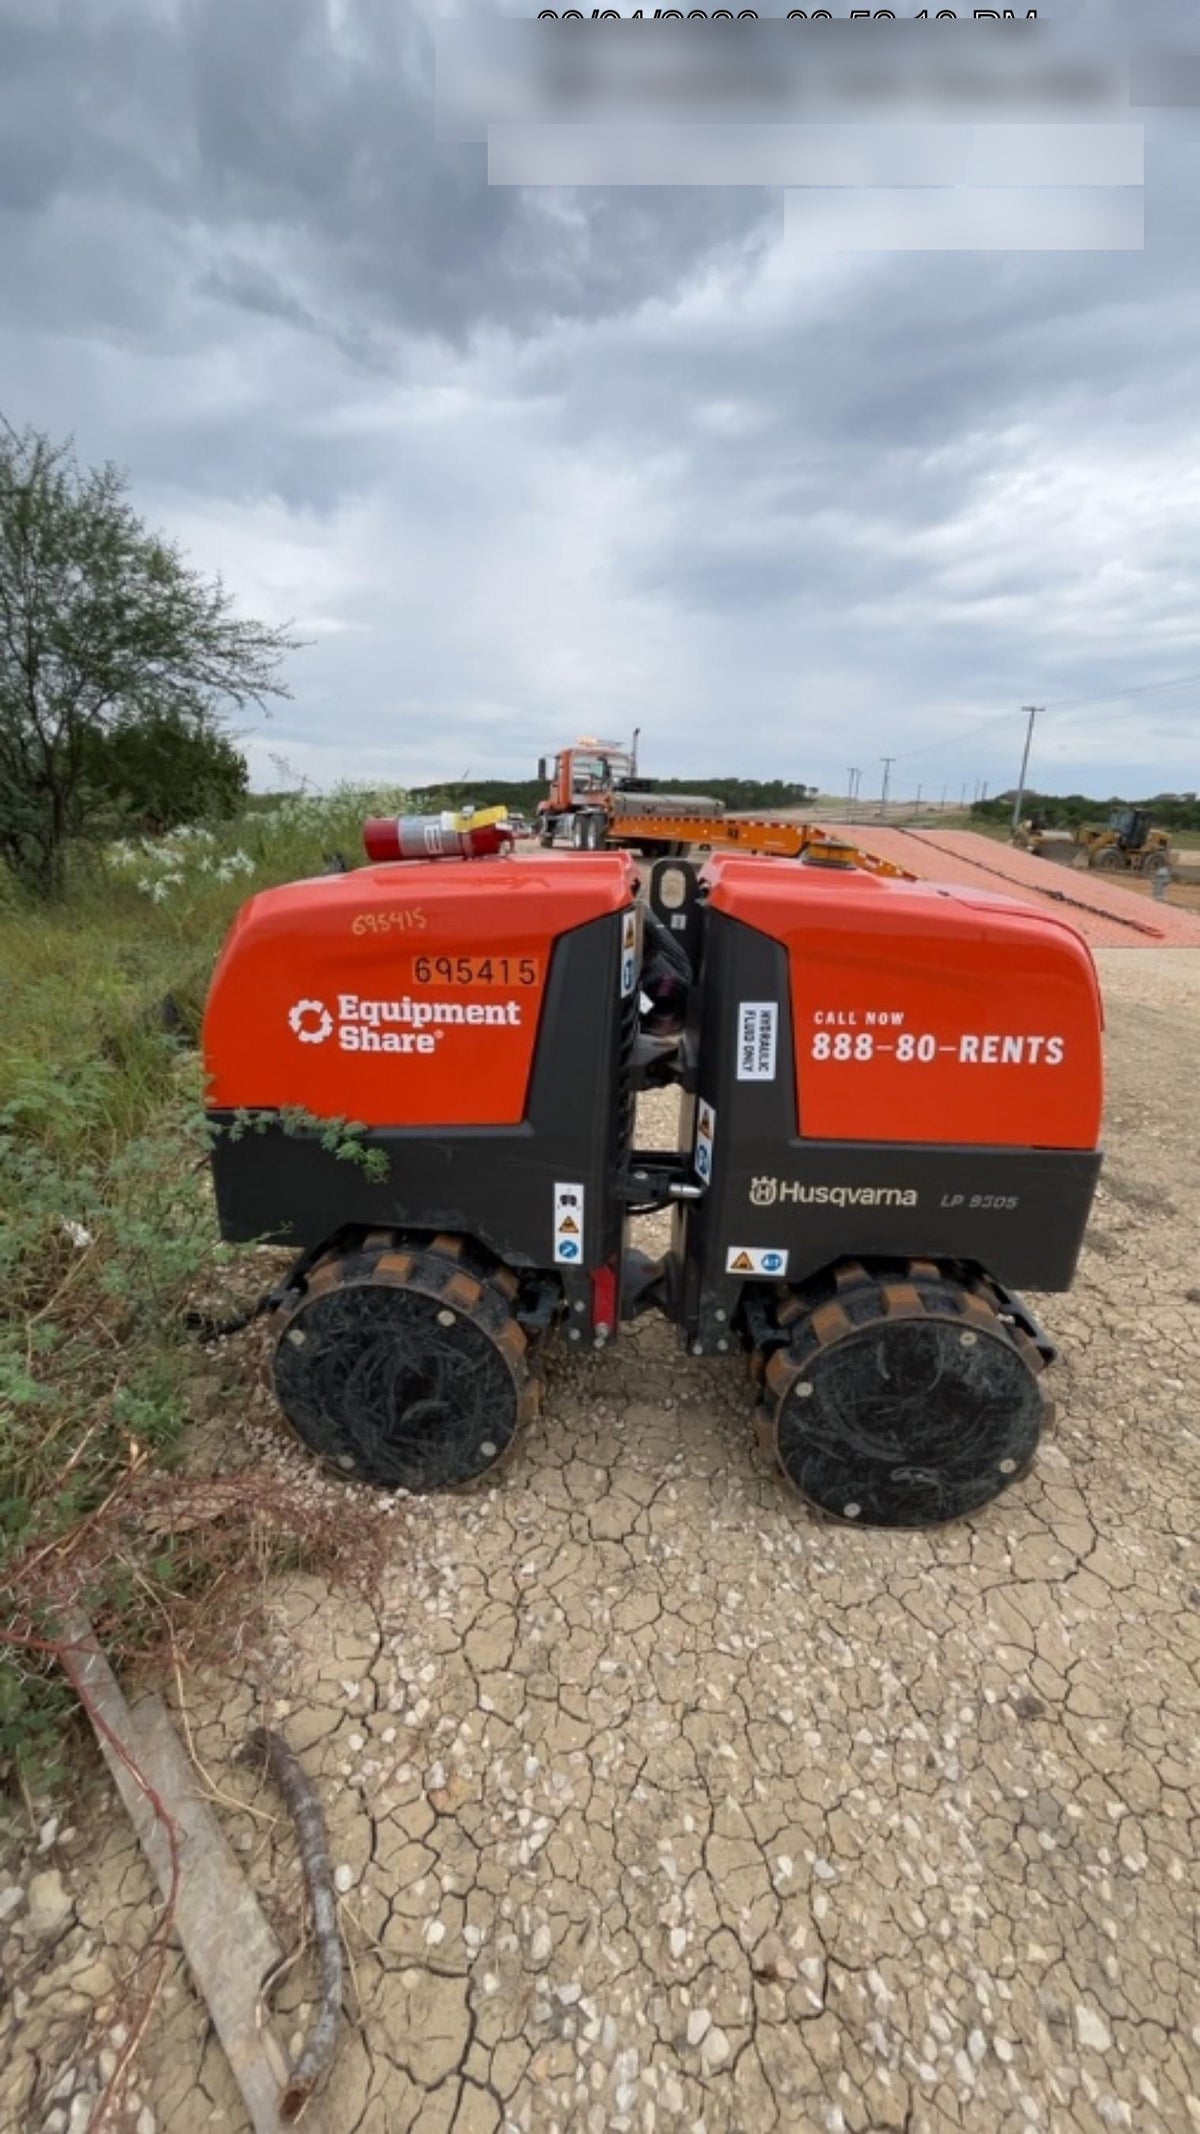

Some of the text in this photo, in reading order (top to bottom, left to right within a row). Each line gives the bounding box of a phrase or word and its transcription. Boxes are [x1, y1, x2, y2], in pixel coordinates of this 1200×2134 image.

[351, 907, 427, 935] 695415
[415, 957, 536, 985] 695415
[337, 995, 521, 1028] Equipment
[815, 1011, 904, 1025] CALL NOW
[758, 1009, 772, 1073] HYDRAULIC
[811, 1032, 1064, 1065] 888-80-RENTS
[742, 1045, 755, 1073] ONLY
[779, 1181, 918, 1208] Husqvarna
[940, 1194, 966, 1208] LP
